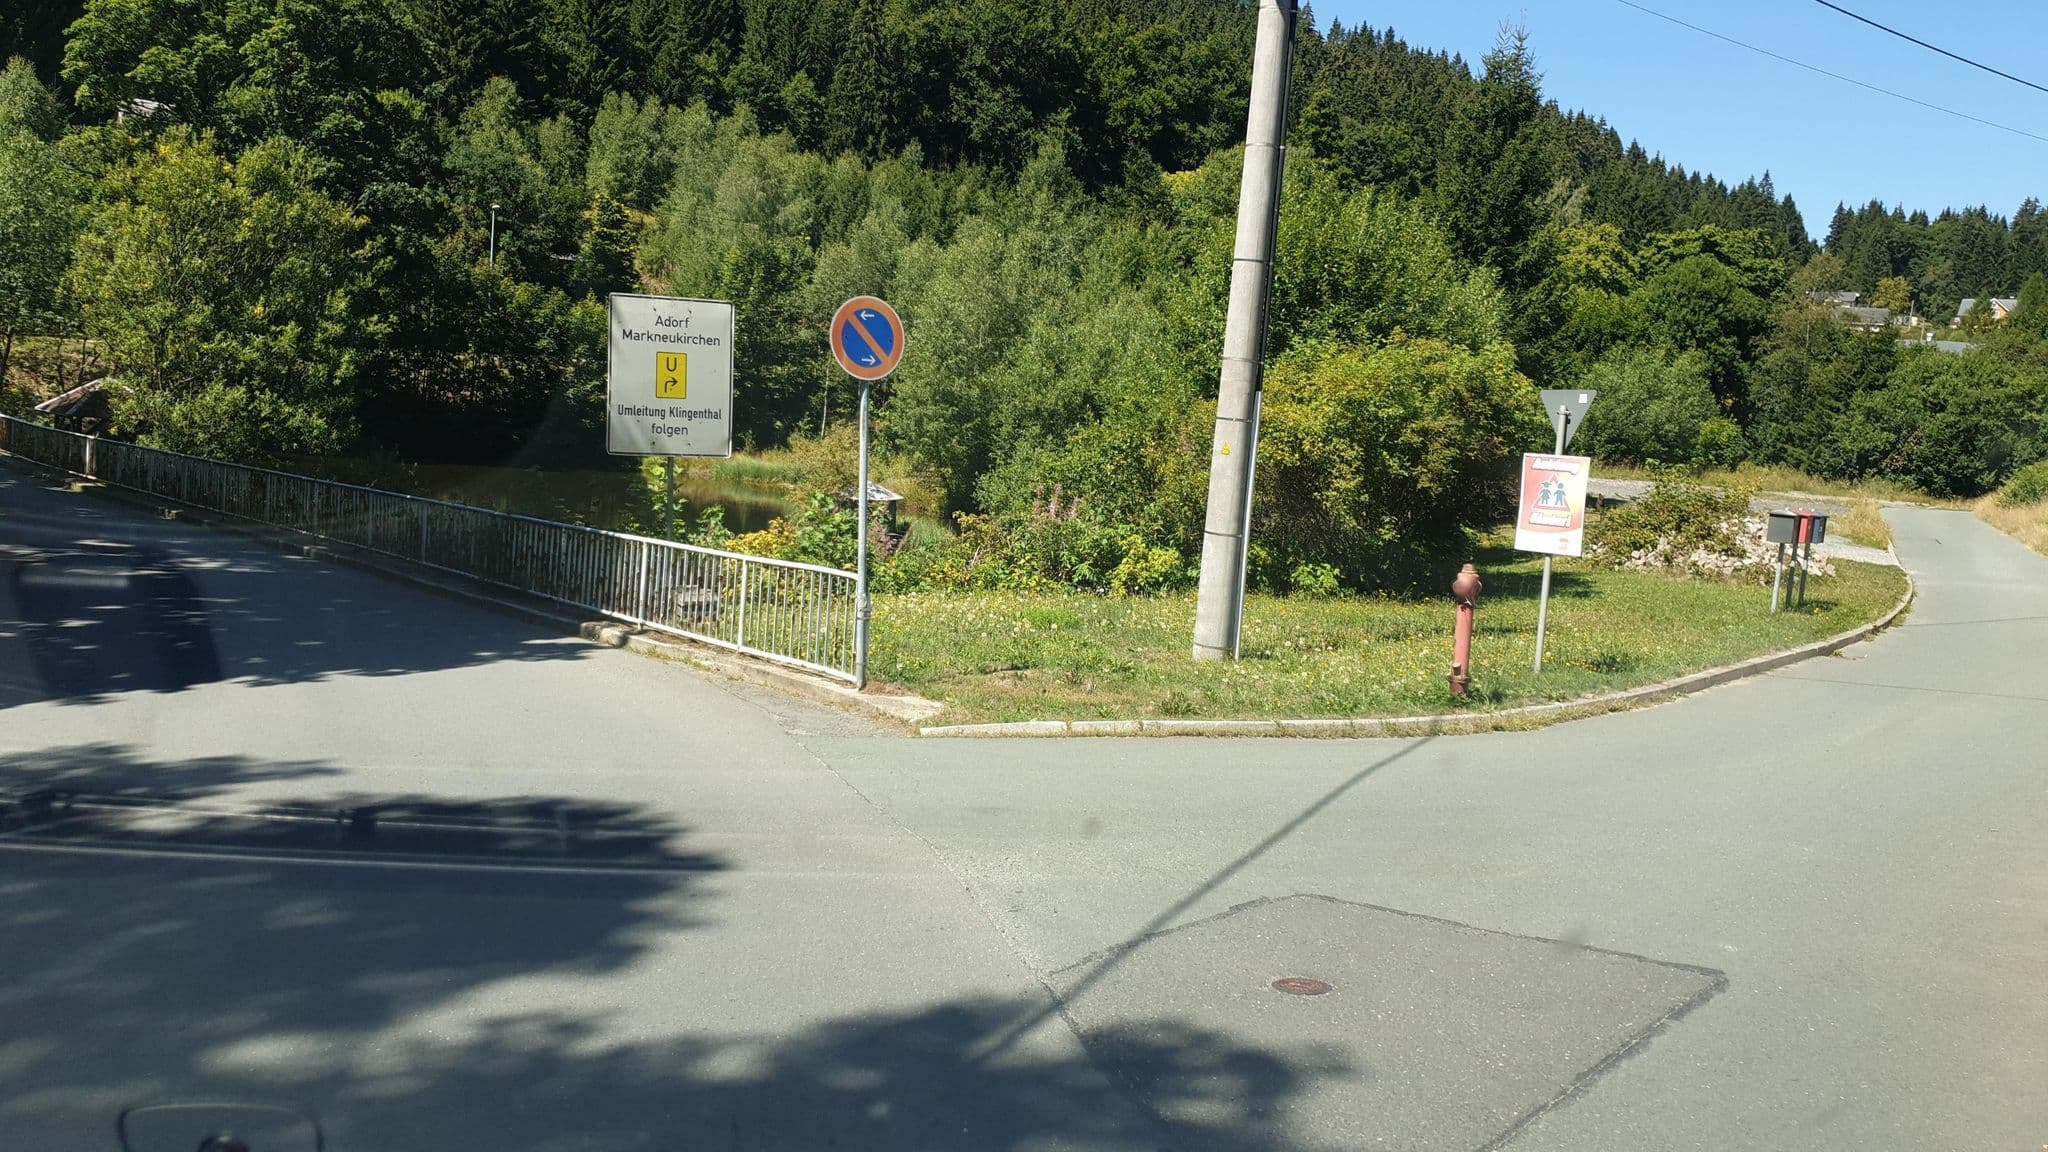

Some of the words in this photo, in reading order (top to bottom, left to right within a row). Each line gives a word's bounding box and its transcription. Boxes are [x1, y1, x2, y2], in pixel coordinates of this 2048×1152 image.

[655, 315, 690, 328] Adorf
[622, 329, 721, 346] Markneukirchen
[666, 357, 677, 372] U
[618, 404, 666, 419] Umleitung
[669, 406, 722, 421] Klingenthal
[651, 423, 688, 437] folgen
